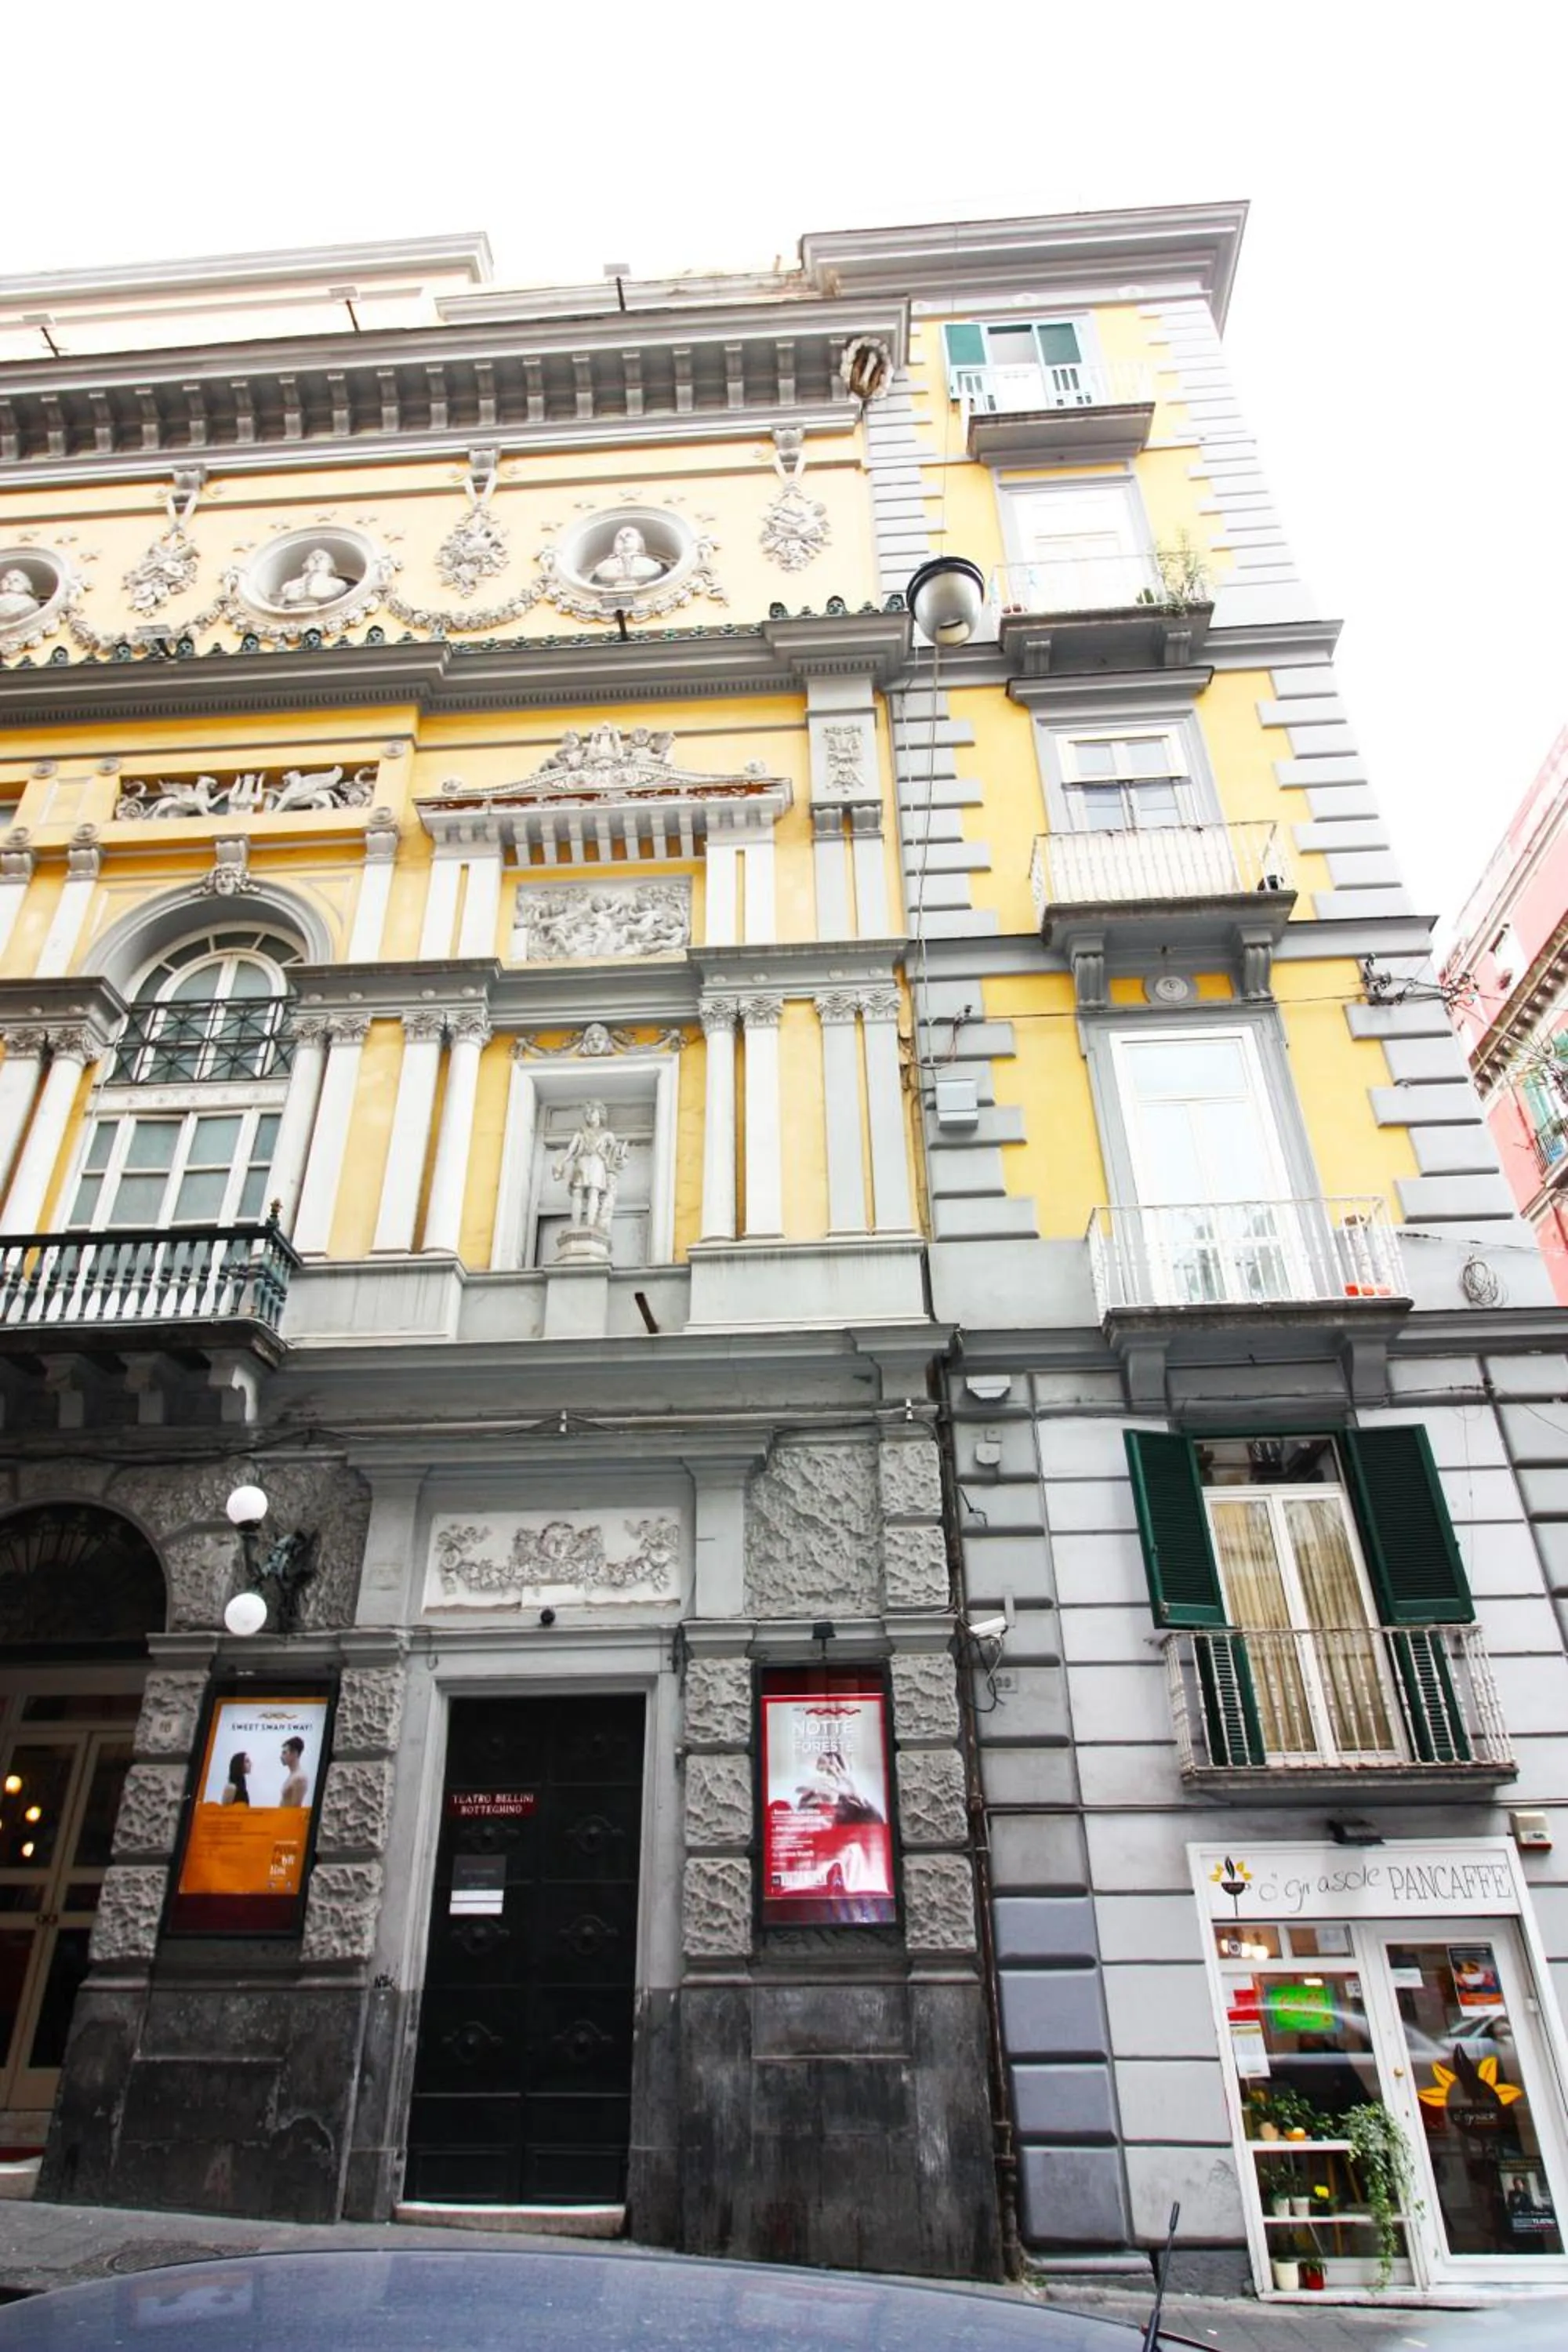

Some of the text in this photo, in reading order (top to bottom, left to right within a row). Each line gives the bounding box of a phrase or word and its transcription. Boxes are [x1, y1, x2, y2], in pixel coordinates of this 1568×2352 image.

[791, 1719, 855, 1737] NOTTE
[793, 1739, 855, 1753] FORESTE
[452, 1793, 534, 1804] TEATRO BELLINI
[460, 1804, 523, 1815] BOTTEGHINO
